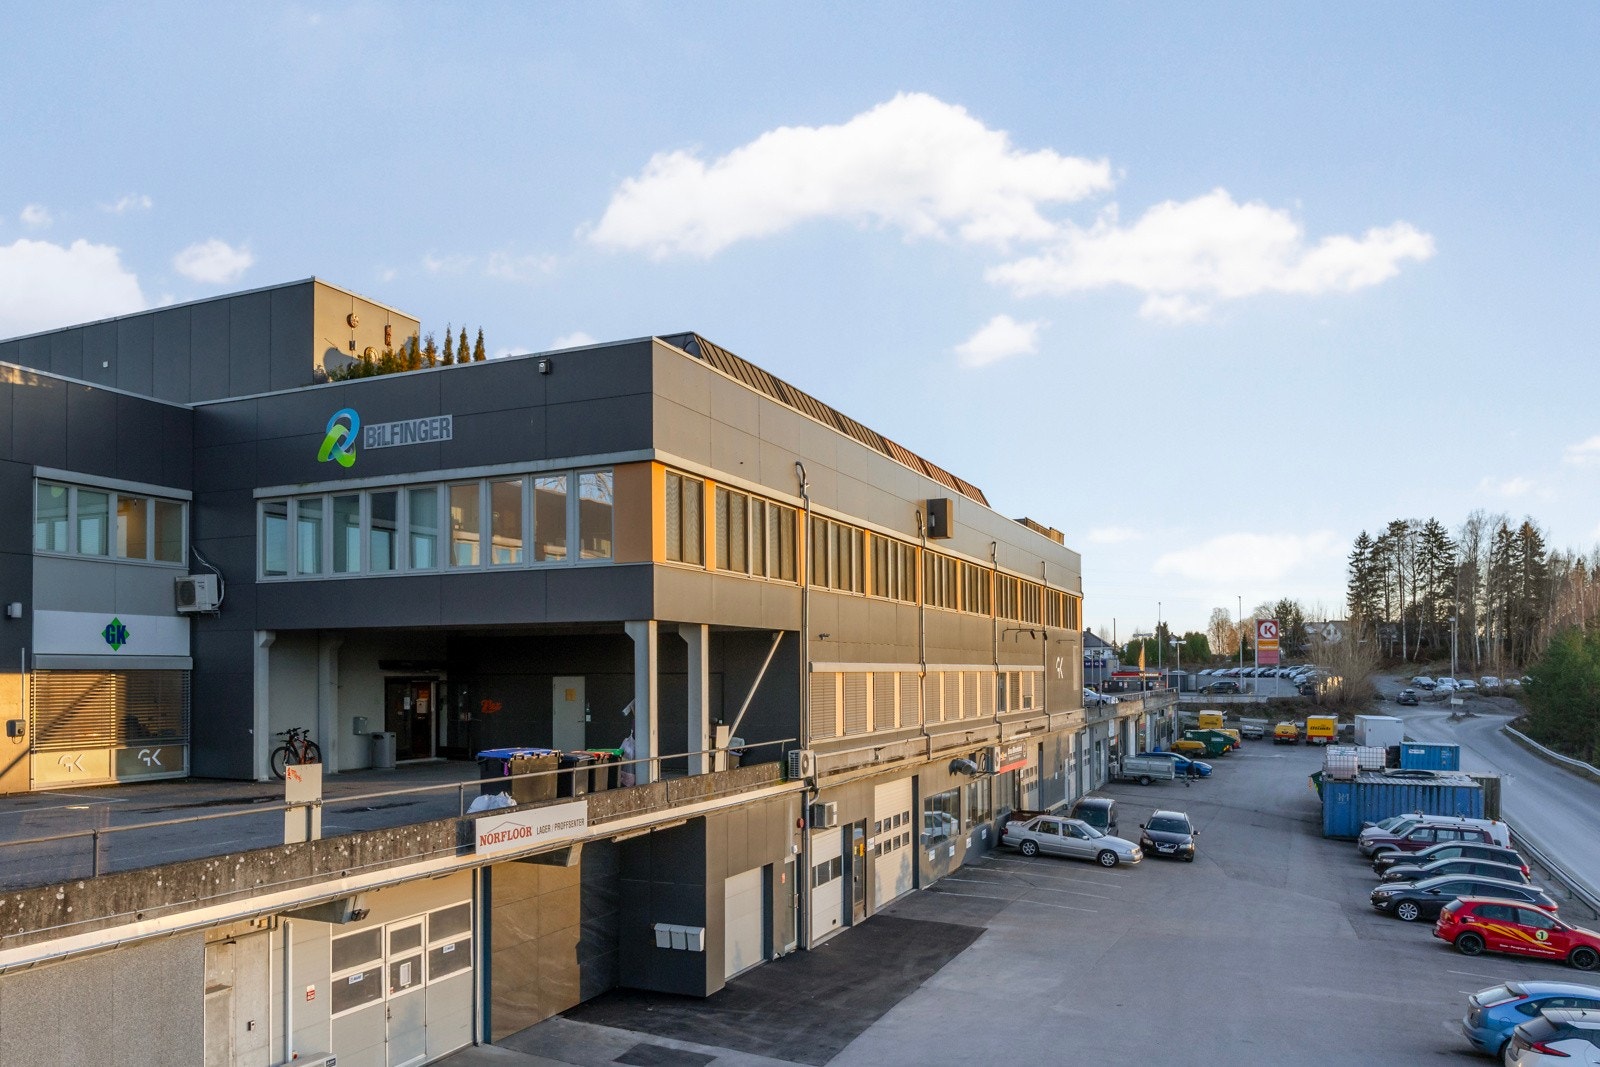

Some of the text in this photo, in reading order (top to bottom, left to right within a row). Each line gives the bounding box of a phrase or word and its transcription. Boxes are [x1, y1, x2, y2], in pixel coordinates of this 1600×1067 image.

[105, 624, 127, 645] GK
[138, 749, 161, 767] GK
[479, 826, 533, 847] NORFLOOR
[536, 823, 551, 835] LAGER
[554, 818, 585, 833] PROFFSENTER
